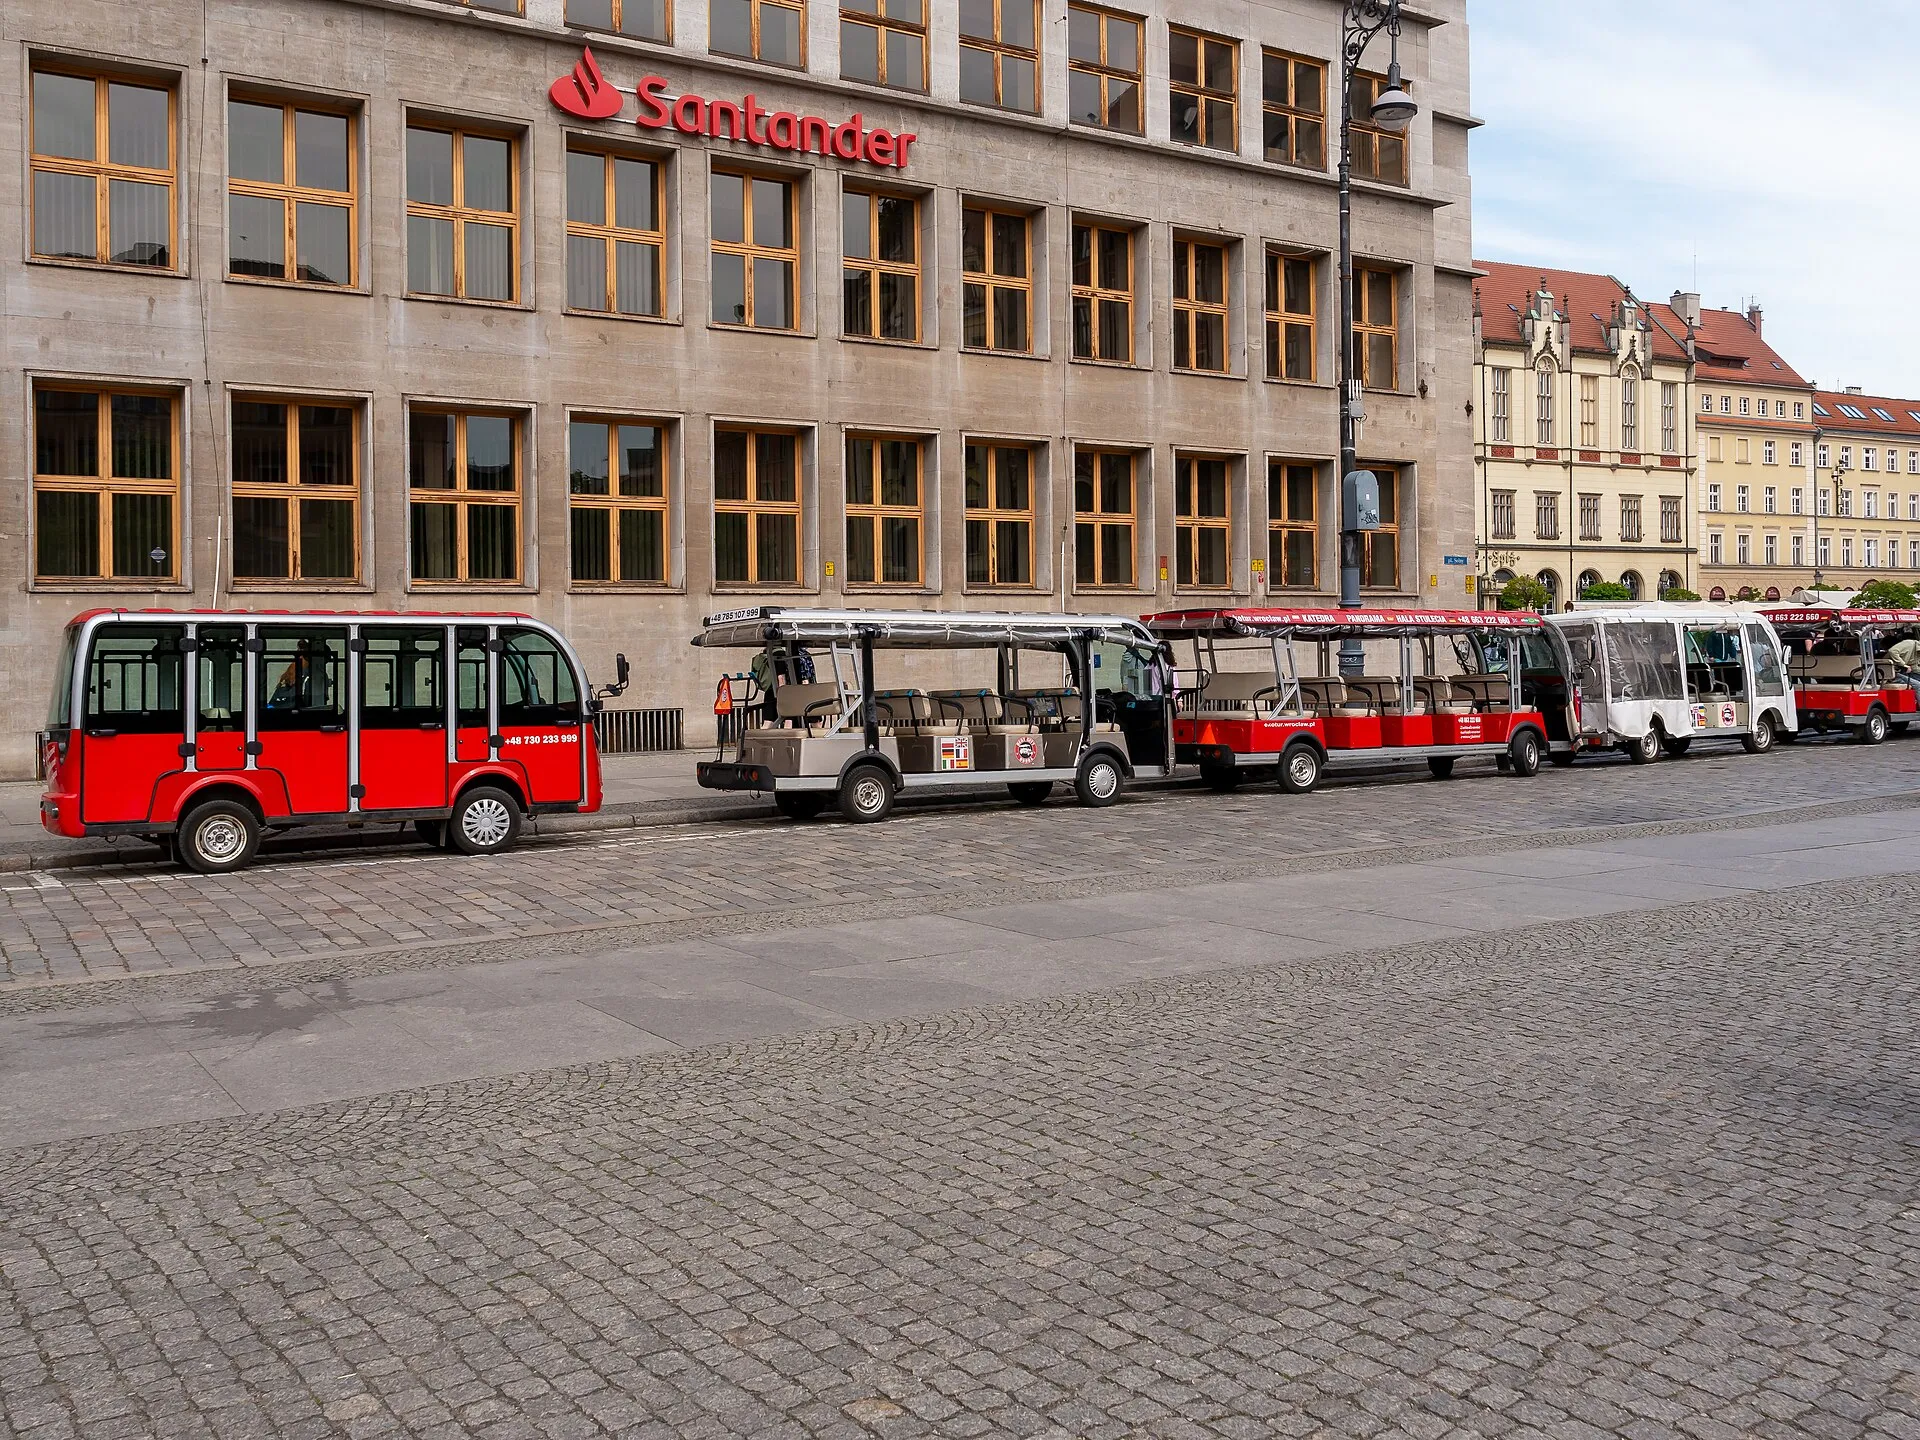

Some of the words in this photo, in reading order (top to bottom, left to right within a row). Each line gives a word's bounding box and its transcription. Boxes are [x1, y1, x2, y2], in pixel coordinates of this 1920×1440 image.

[635, 75, 917, 168] Santander
[722, 612, 734, 620] 785
[735, 610, 746, 618] 107
[746, 608, 759, 616] 999
[1301, 614, 1336, 623] KATEDRA
[1345, 614, 1386, 623] PANORAMA
[1395, 614, 1415, 623] HALA
[1415, 614, 1447, 623] STULECIA
[1775, 613, 1788, 621] 663
[1790, 613, 1804, 621] 222
[1458, 615, 1470, 623] +48
[1484, 615, 1498, 624] 222
[504, 736, 522, 745] +48
[524, 735, 541, 744] 730
[542, 735, 560, 744] 233
[560, 734, 578, 743] 999
